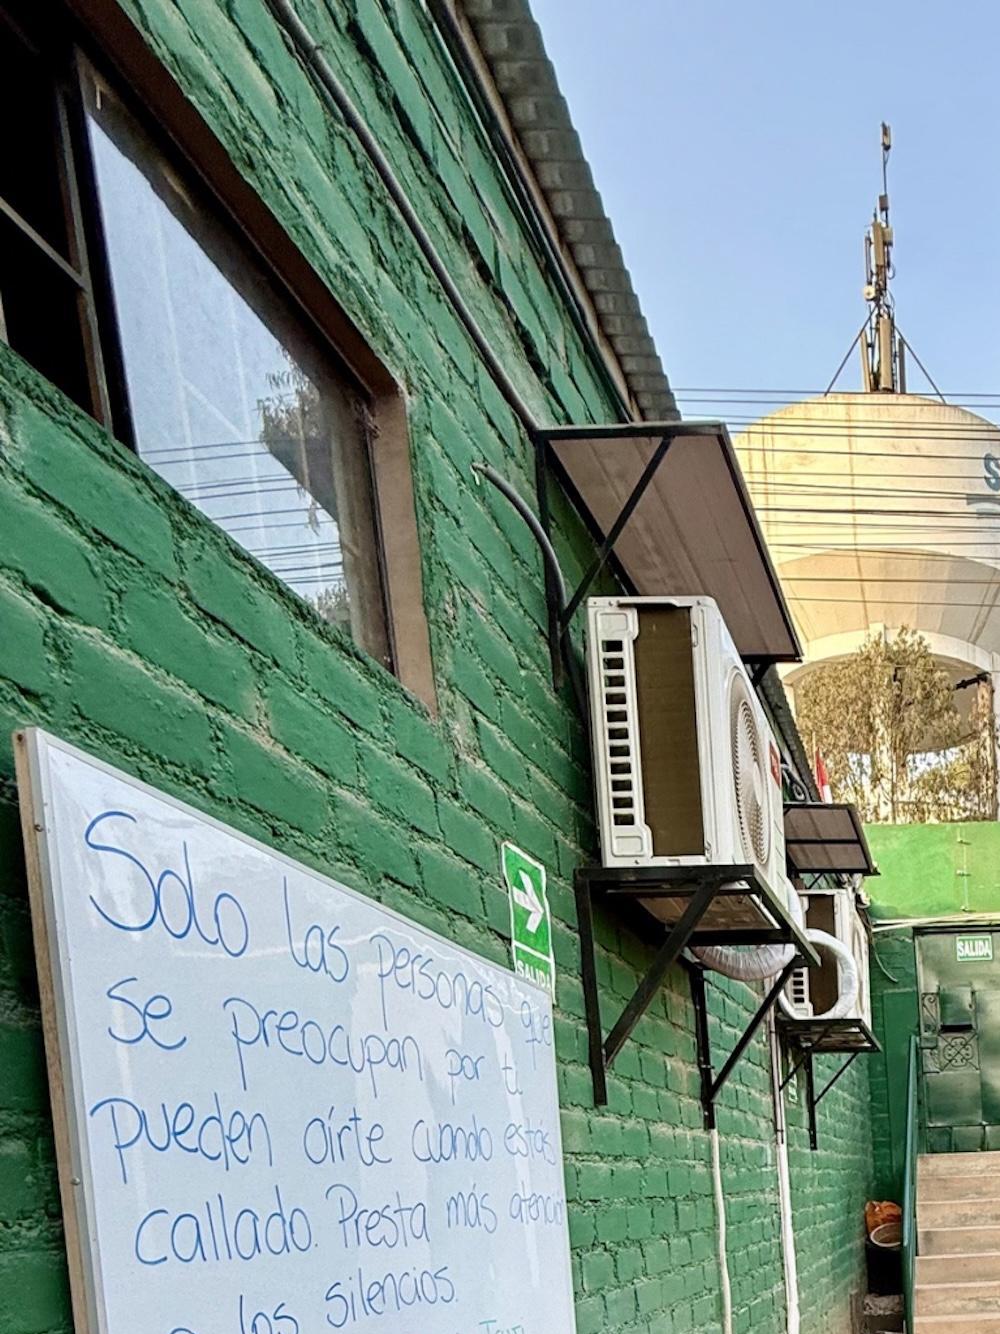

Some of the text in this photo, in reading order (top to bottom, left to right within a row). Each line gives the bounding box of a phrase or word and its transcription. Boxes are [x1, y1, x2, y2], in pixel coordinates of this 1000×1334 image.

[84, 810, 552, 1071] Solo las personas que
[957, 939, 991, 957] SALIDA
[516, 959, 552, 992] SALIDA
[222, 996, 424, 1099] preocupan
[444, 1048, 486, 1106] por
[411, 1113, 493, 1164] cuando
[503, 1116, 557, 1166] estás
[325, 1183, 431, 1249] Presta
[446, 1182, 498, 1234] más
